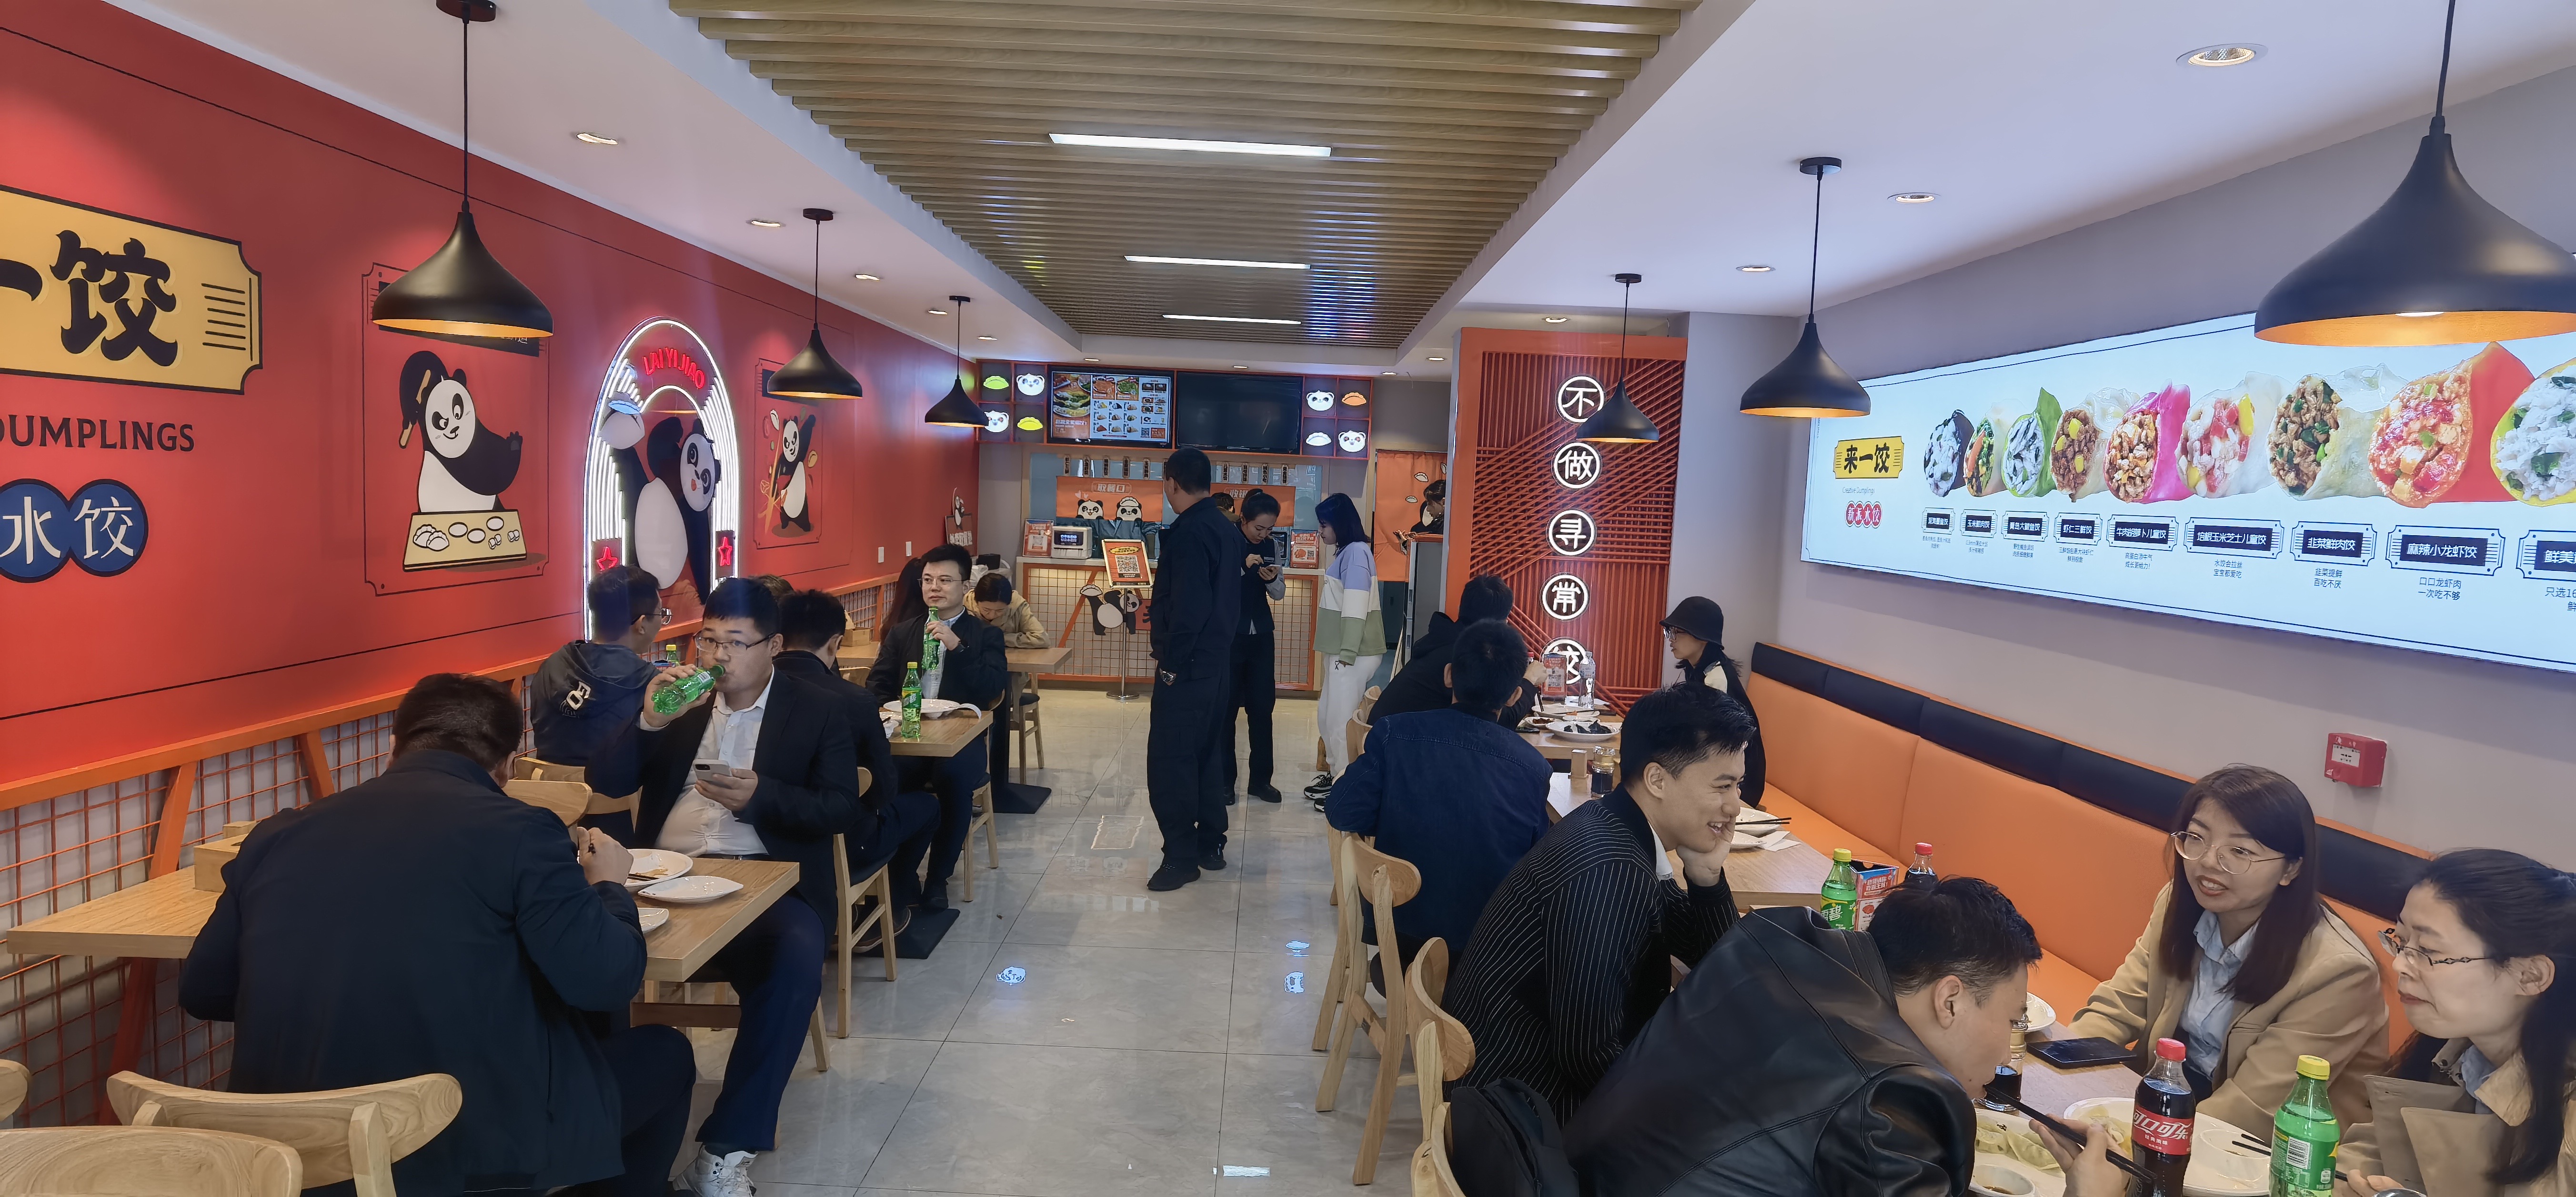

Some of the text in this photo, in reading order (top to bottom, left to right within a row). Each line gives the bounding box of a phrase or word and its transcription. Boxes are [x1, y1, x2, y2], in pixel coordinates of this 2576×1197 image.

[644, 347, 705, 389] LAI YI JIAO
[1844, 442, 1890, 474] 来一饺
[1097, 483, 1125, 493] 取餐口
[1856, 487, 1875, 496] Dumplings
[1967, 519, 1990, 528] 玉米鲜肉饺
[2063, 524, 2093, 534] 虾仁三鲜饺
[2116, 527, 2167, 539] 牛肉胡萝卜儿童饺
[2196, 531, 2267, 545] 培根玉米芝士儿童饺
[2307, 537, 2356, 550] 韭菜鲜肉饺
[2407, 543, 2477, 558] 麻辣小龙虾饺
[2543, 549, 2576, 564] 鲜美
[2213, 569, 2242, 578] 宝宝都爱吃
[2314, 578, 2342, 588] 百吃不厌
[2419, 577, 2462, 589] 口口龙虾肉
[2417, 589, 2461, 600] 一次吃不够
[2133, 1109, 2192, 1140] 可口可乐
